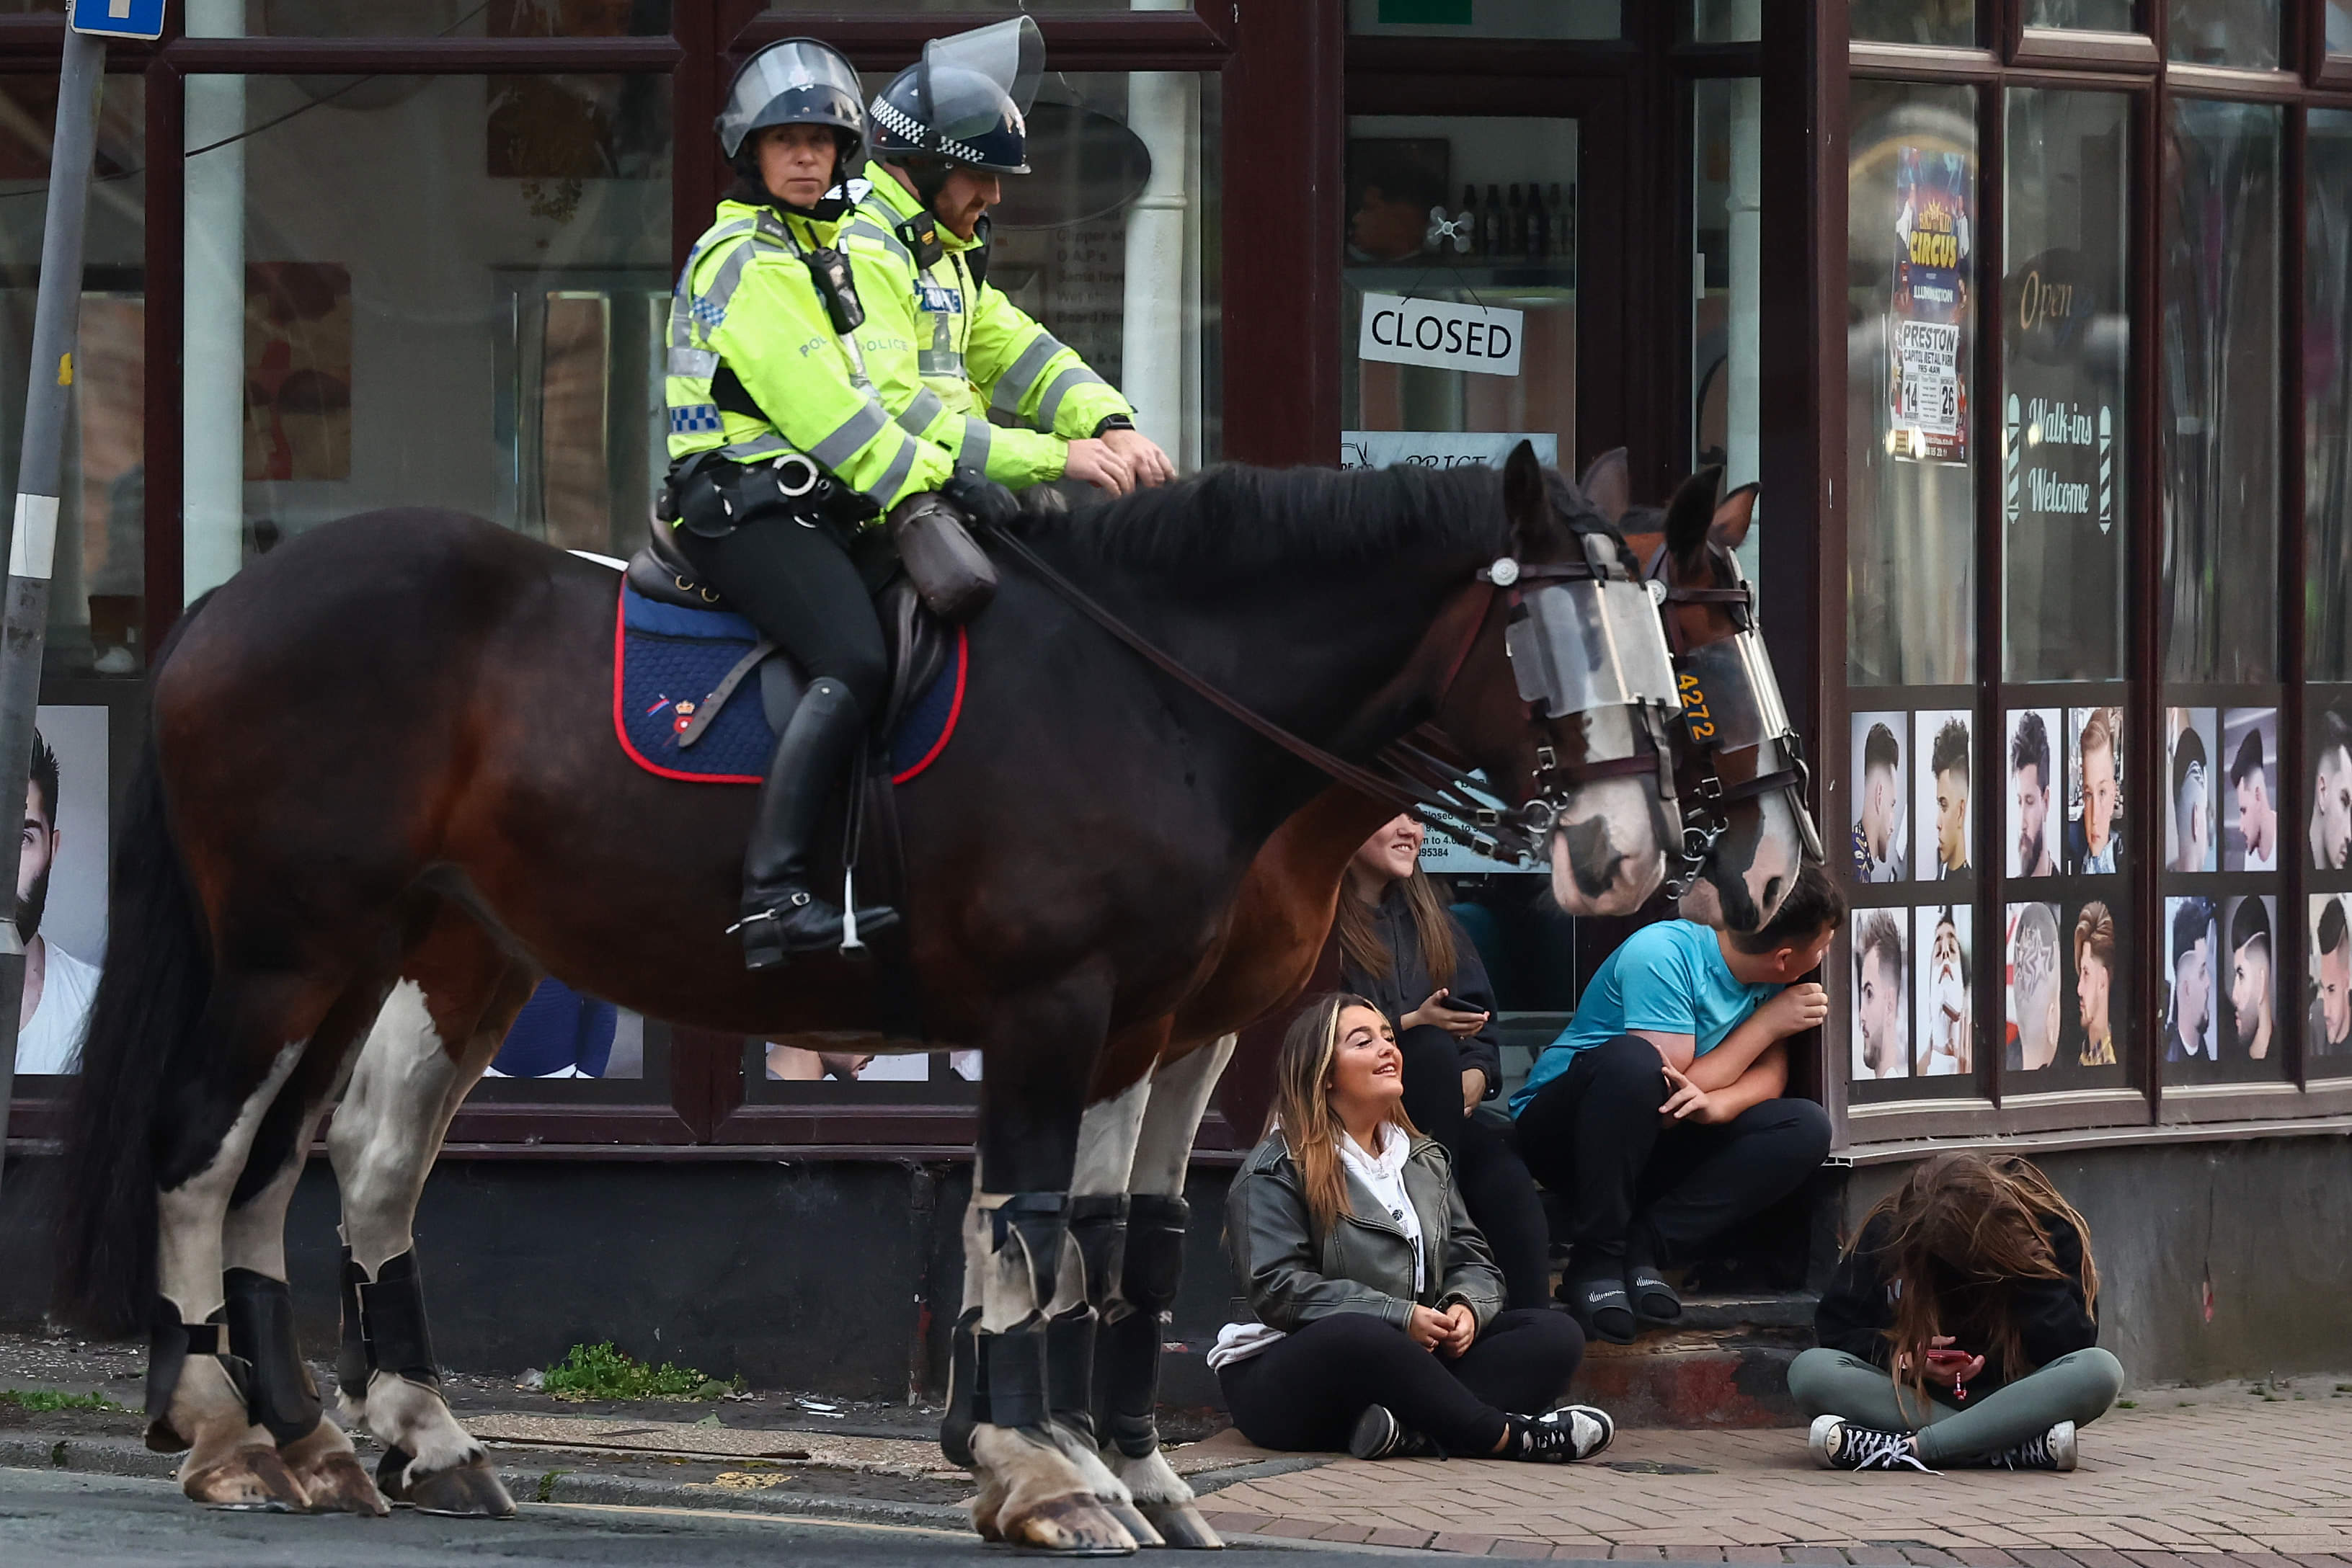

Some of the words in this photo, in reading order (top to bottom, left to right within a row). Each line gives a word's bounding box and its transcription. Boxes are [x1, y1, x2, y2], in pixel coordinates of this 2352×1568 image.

[1909, 231, 1957, 269] CIRCUS
[1913, 285, 1953, 303] ILLUMINATION
[2020, 271, 2072, 332] Open
[1372, 310, 1512, 359] CLOSED
[1904, 324, 1956, 352] PRESTON
[1905, 381, 1917, 412] 14
[1942, 386, 1954, 416] 26
[2028, 398, 2092, 445] Walk-ins
[2028, 467, 2090, 514] Welcome
